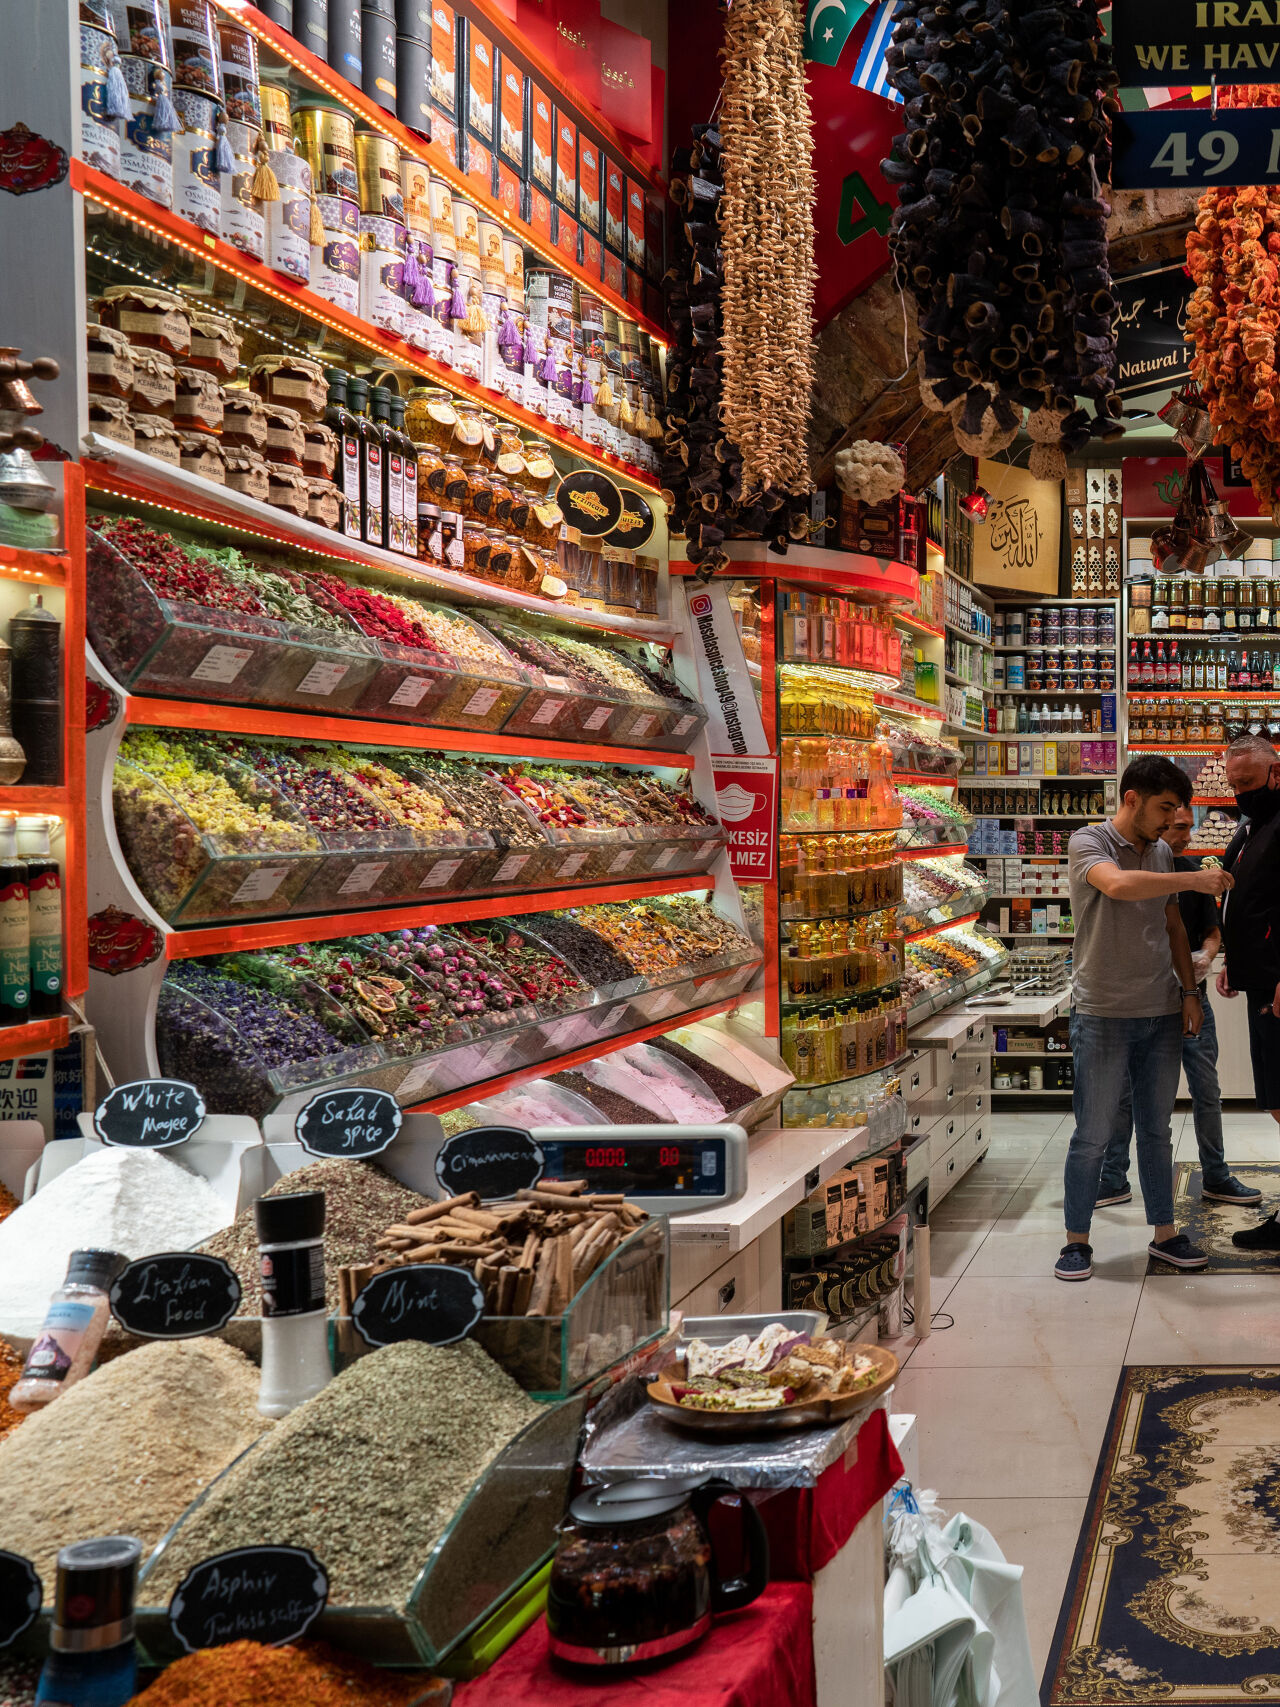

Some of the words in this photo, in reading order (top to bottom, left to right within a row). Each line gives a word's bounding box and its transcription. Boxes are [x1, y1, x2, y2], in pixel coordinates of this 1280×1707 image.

[1134, 44, 1190, 71] WE
[1149, 130, 1240, 177] 49
[1118, 349, 1179, 379] Natural
[572, 492, 606, 514] Erzincan
[729, 828, 769, 847] KESİZ
[728, 850, 767, 867] LMEZ
[121, 1084, 186, 1111] White
[381, 1279, 439, 1324] Mint
